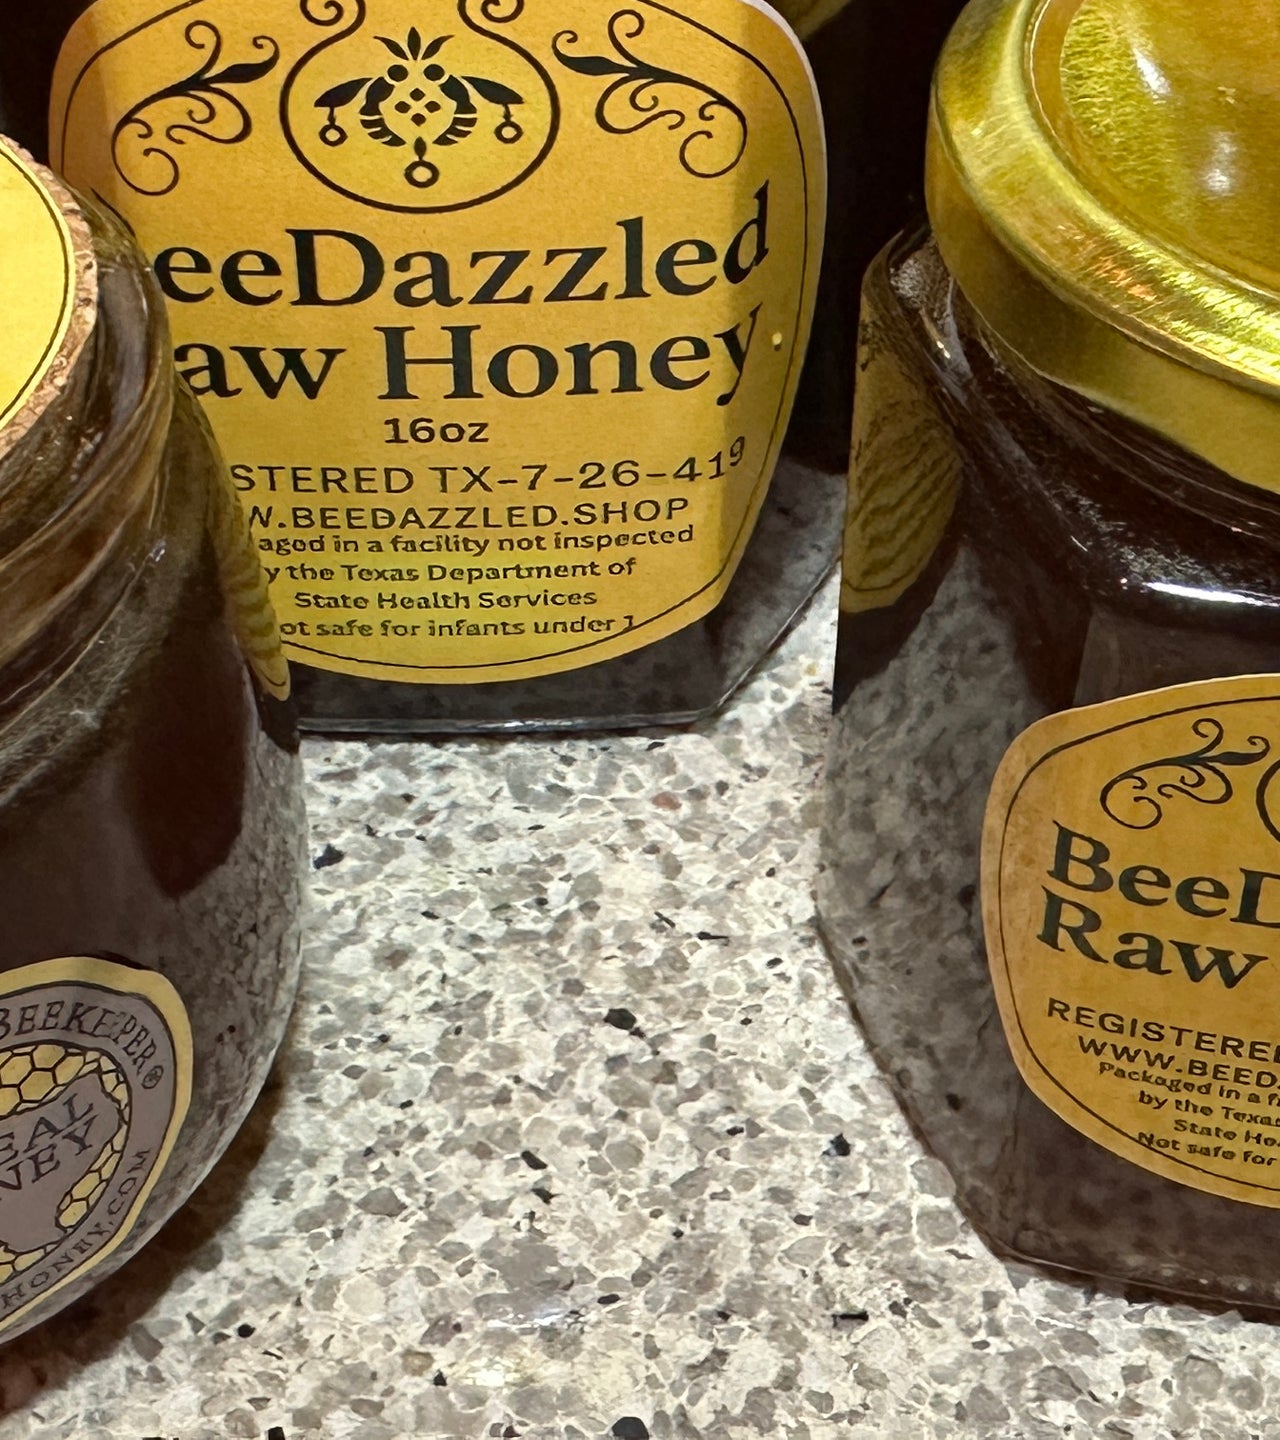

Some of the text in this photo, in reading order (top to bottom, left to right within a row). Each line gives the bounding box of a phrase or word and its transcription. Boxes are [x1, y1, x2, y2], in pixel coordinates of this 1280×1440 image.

[153, 180, 770, 307] eeDazzled
[173, 302, 763, 406] aw Honey
[384, 417, 489, 444] 16oz
[230, 436, 745, 494] STERED TX-7-26-419
[249, 497, 689, 530] W.BEEDAZZLED.SHOP
[258, 524, 694, 557] aged in a facility not inspected
[264, 558, 637, 584] y the Texas Department of
[294, 589, 598, 610] State Health Services
[280, 621, 311, 636] ot
[316, 619, 373, 637] safe
[380, 619, 420, 637] for
[428, 618, 526, 637] infants
[533, 615, 616, 634] under
[1036, 886, 1269, 990] Raw
[1099, 1061, 1212, 1094] Packaged
[1219, 1085, 1240, 1100] in
[1248, 1092, 1261, 1104] a
[1139, 1090, 1168, 1110] by
[1175, 1099, 1213, 1117] the
[1173, 1119, 1237, 1142] State
[1138, 1131, 1180, 1151] Not
[1187, 1142, 1236, 1160] safe
[1242, 1150, 1280, 1168] for
